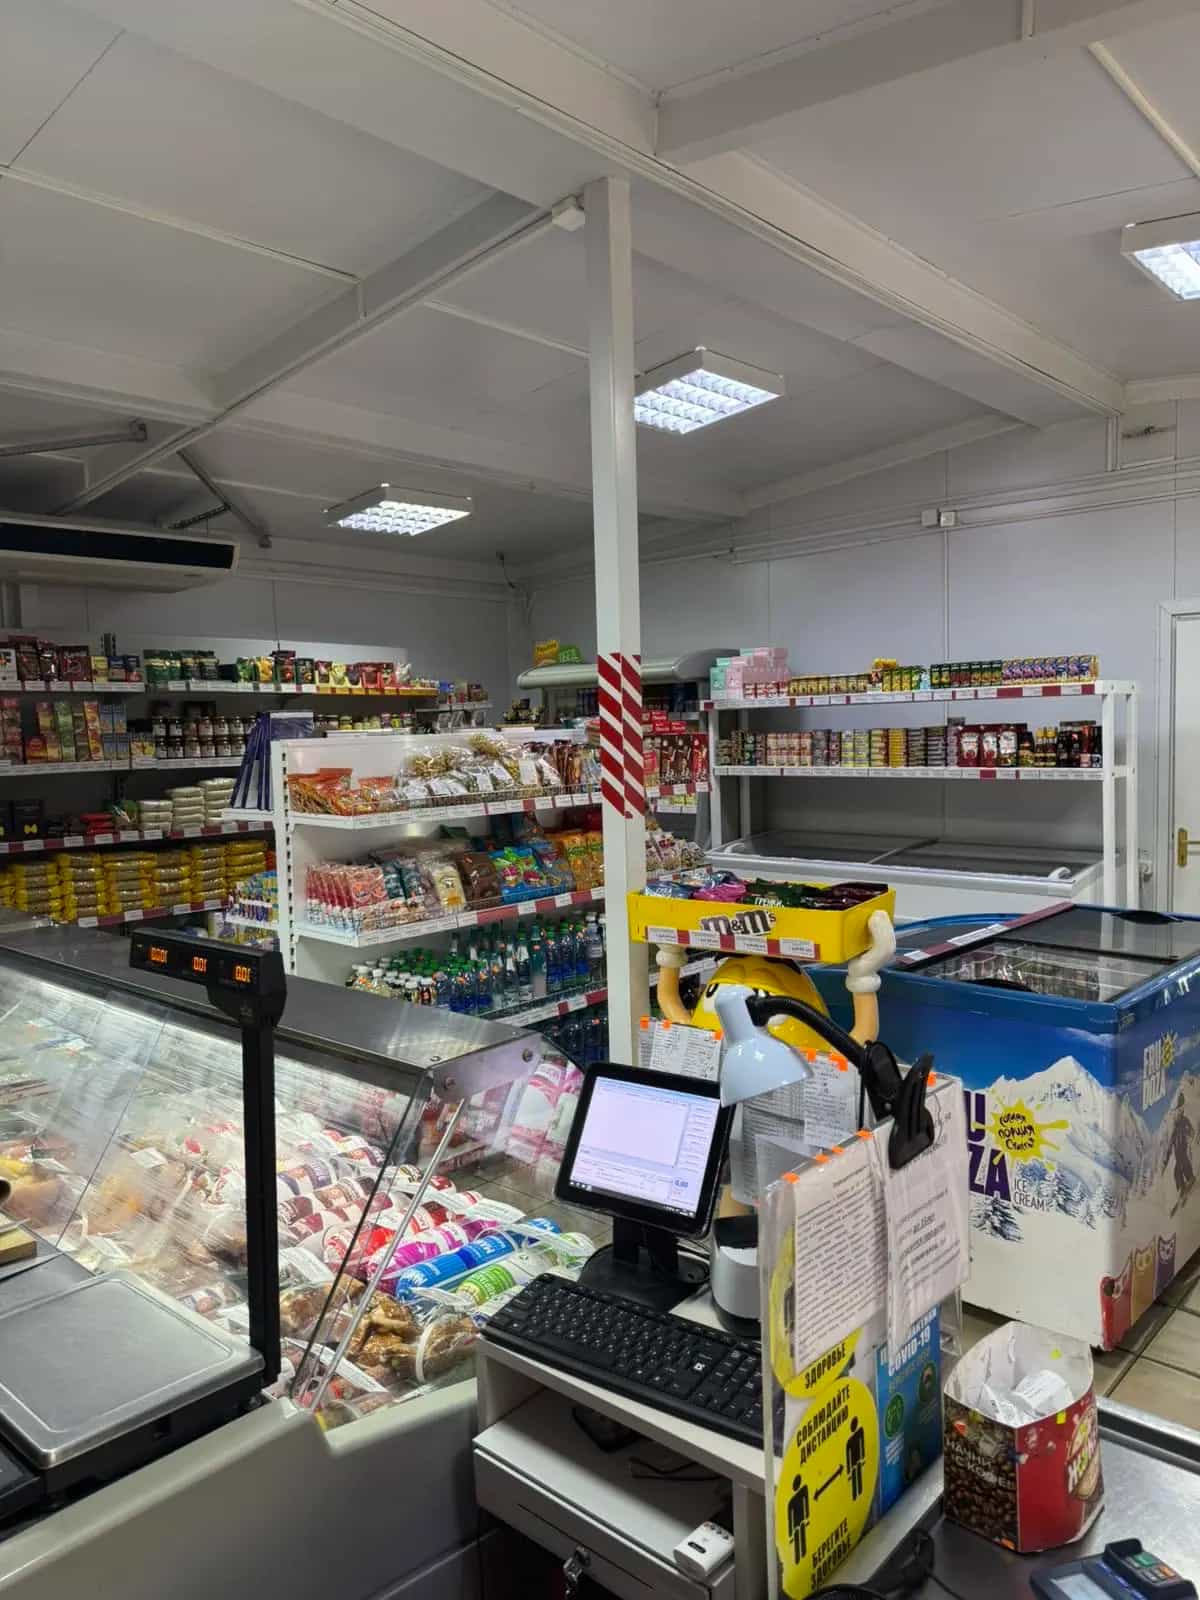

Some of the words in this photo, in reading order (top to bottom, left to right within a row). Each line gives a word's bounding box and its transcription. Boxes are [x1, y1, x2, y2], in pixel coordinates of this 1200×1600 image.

[1013, 1191, 1046, 1212] CREAM
[1014, 1178, 1027, 1194] ICE
[804, 1343, 846, 1390] ЗДОРОВЬЕ
[796, 1383, 850, 1449] СОБЛЮДАЙТЕ
[800, 1404, 849, 1467] ДИСТАНЦИЮ
[811, 1516, 849, 1569] БЕРЕГИТЕ
